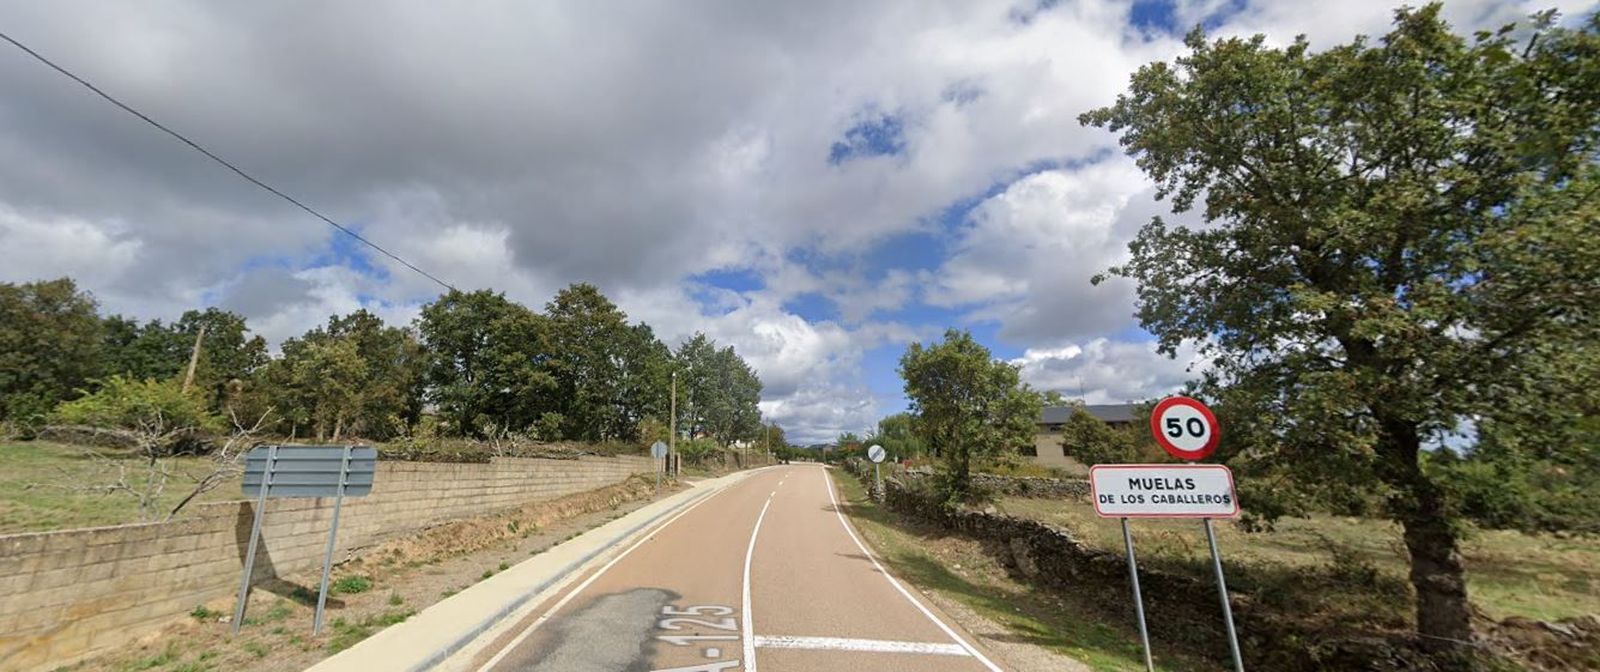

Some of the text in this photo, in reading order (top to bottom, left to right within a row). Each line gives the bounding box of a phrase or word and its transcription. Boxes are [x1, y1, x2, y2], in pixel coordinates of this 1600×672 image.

[1166, 417, 1205, 438] 50
[1128, 477, 1196, 491] MUELAS
[1099, 494, 1231, 505] DE LOS CABALLEROS
